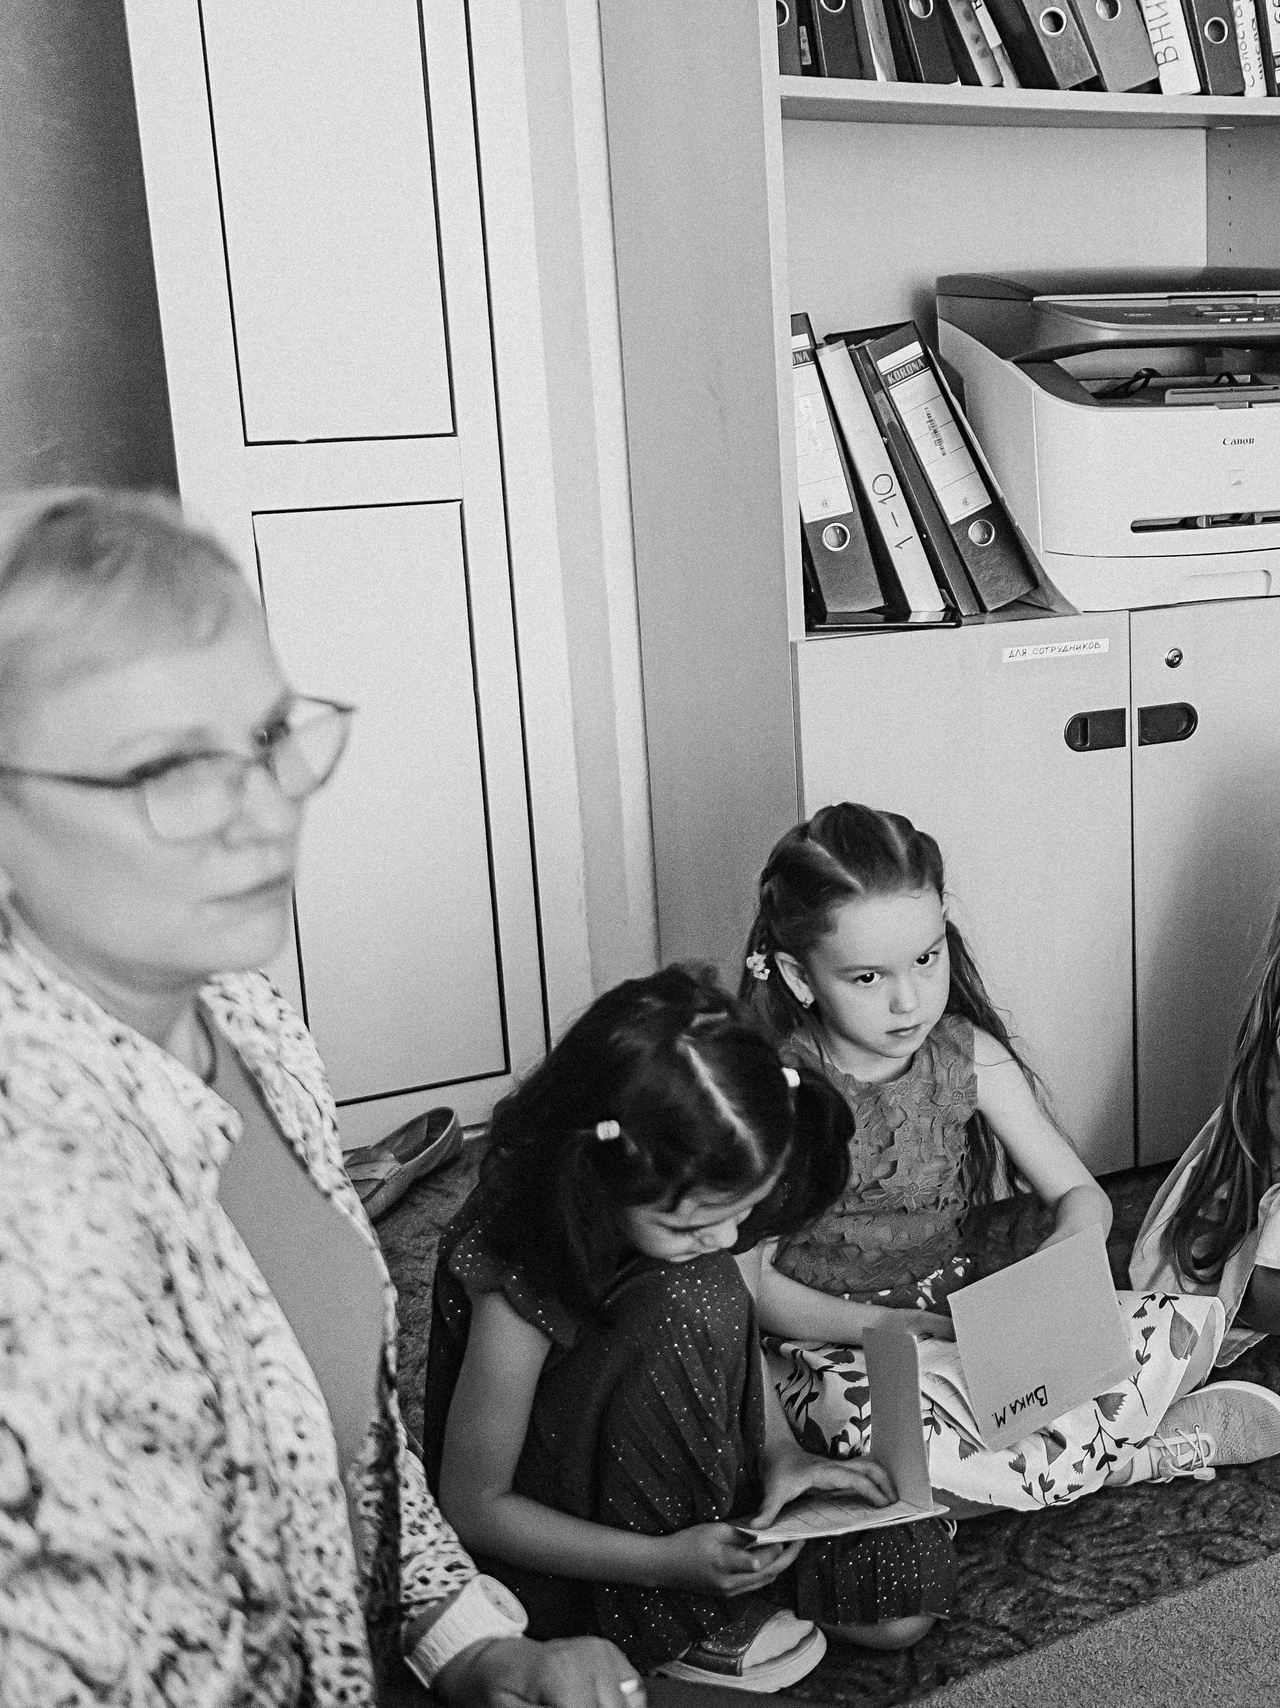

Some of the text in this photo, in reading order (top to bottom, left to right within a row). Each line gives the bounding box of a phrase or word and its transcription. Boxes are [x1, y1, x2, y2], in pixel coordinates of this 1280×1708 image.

[887, 358, 926, 385] KORONA
[1222, 437, 1255, 446] Canon
[1008, 641, 1101, 659] ДЛЯ СОТРУДНИКОВ
